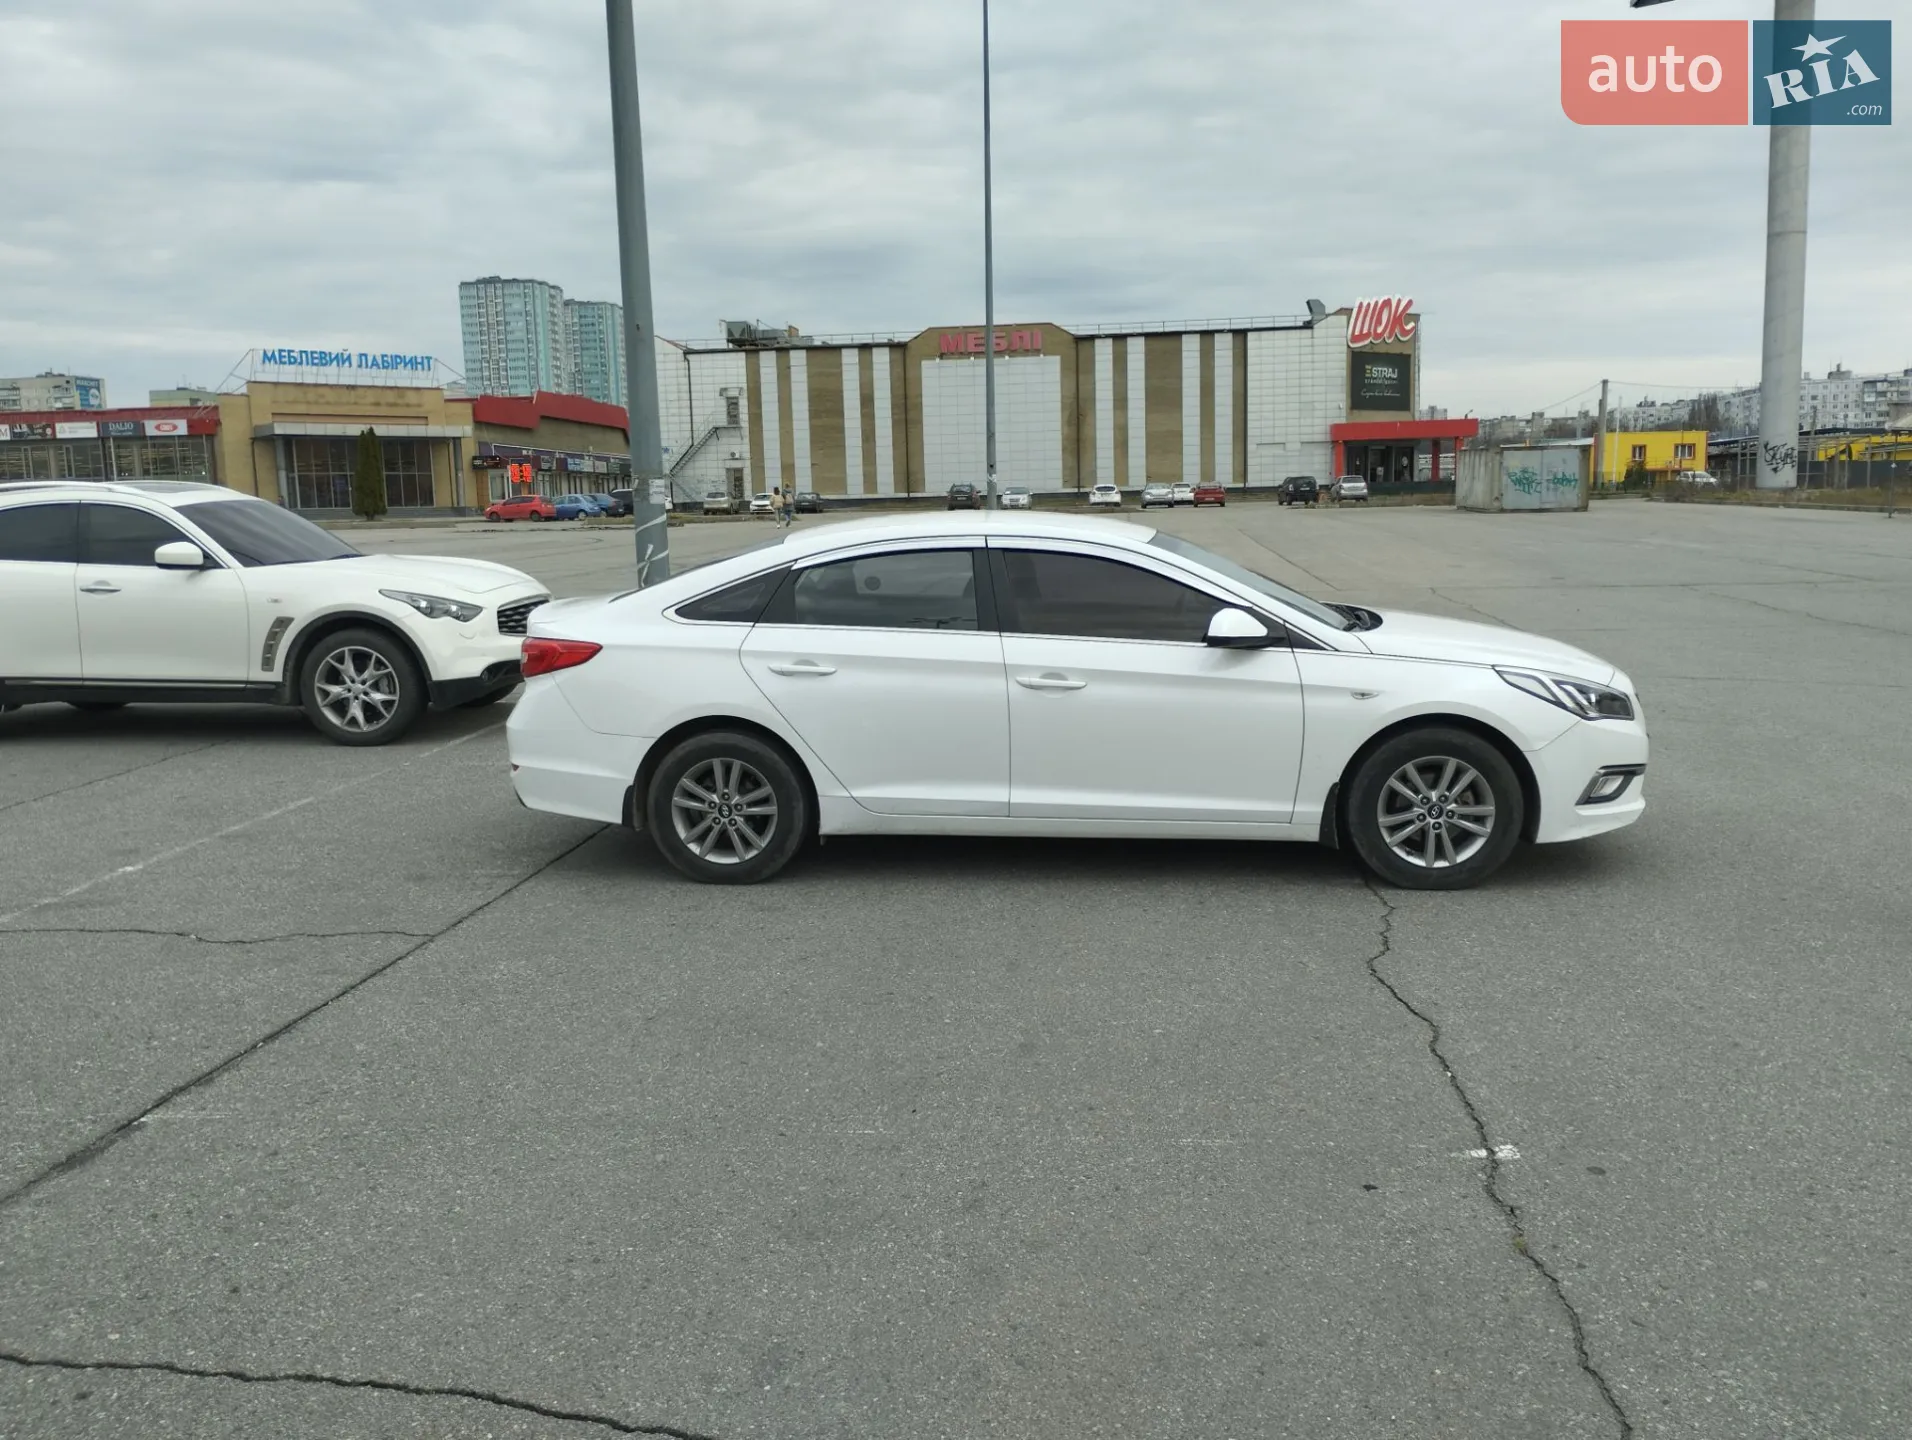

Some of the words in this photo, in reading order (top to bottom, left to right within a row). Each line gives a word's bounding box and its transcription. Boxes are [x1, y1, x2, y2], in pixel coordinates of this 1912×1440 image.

[1347, 295, 1416, 347] ШОК
[940, 329, 1042, 354] МЕБЛІ
[262, 348, 352, 368] МЕБЛЕВИЙ
[357, 353, 433, 371] ЛАБІРИНТ
